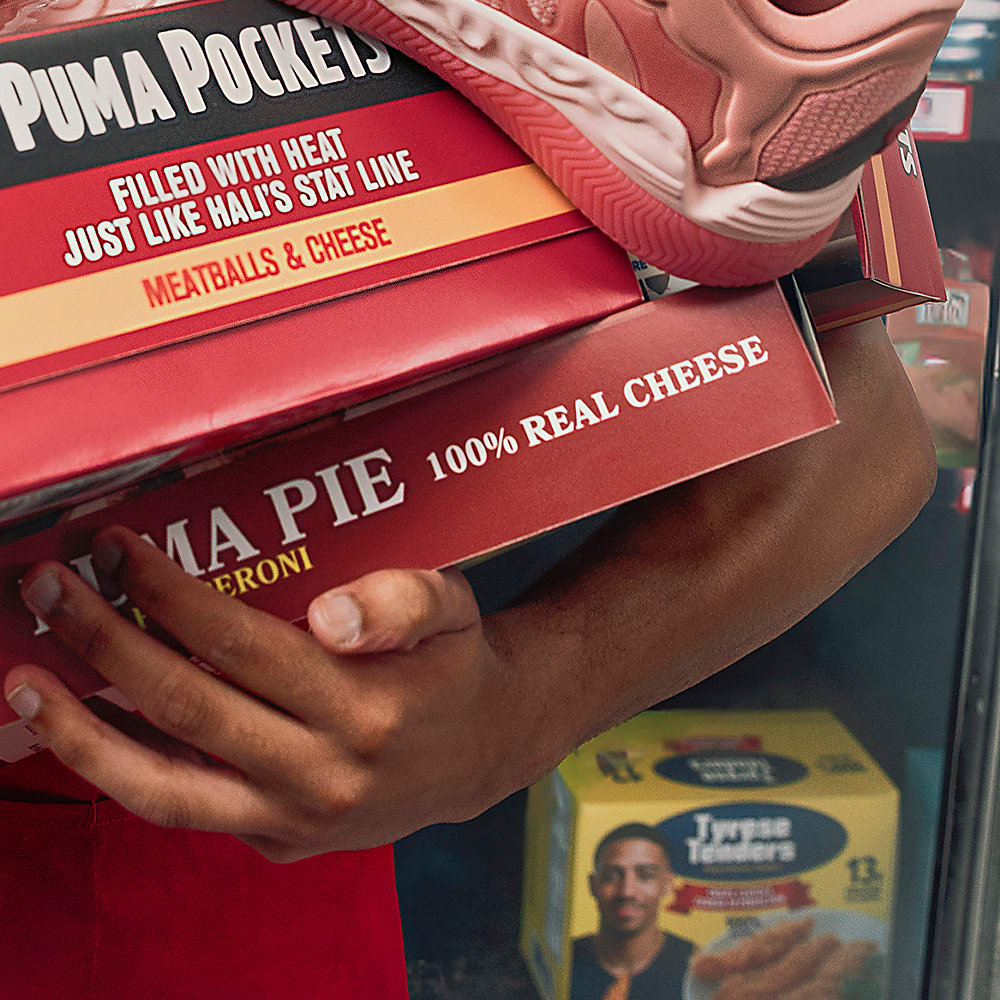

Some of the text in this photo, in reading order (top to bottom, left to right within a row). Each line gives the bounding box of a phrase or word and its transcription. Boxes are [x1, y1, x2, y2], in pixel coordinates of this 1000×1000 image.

[157, 16, 392, 115] POCKETS
[63, 149, 420, 268] JUST LIKE HALI'S STAT LINE
[109, 127, 348, 213] FILLED WITH HEAT
[140, 217, 393, 309] MEATBALLS & CHEESE
[263, 447, 405, 548] PIE
[426, 426, 519, 482] 100%
[519, 391, 620, 448] REAL
[623, 335, 770, 409] CHEESE
[204, 545, 315, 598] ERONI
[684, 837, 798, 866] Tenders
[692, 812, 793, 844] Tyrese
